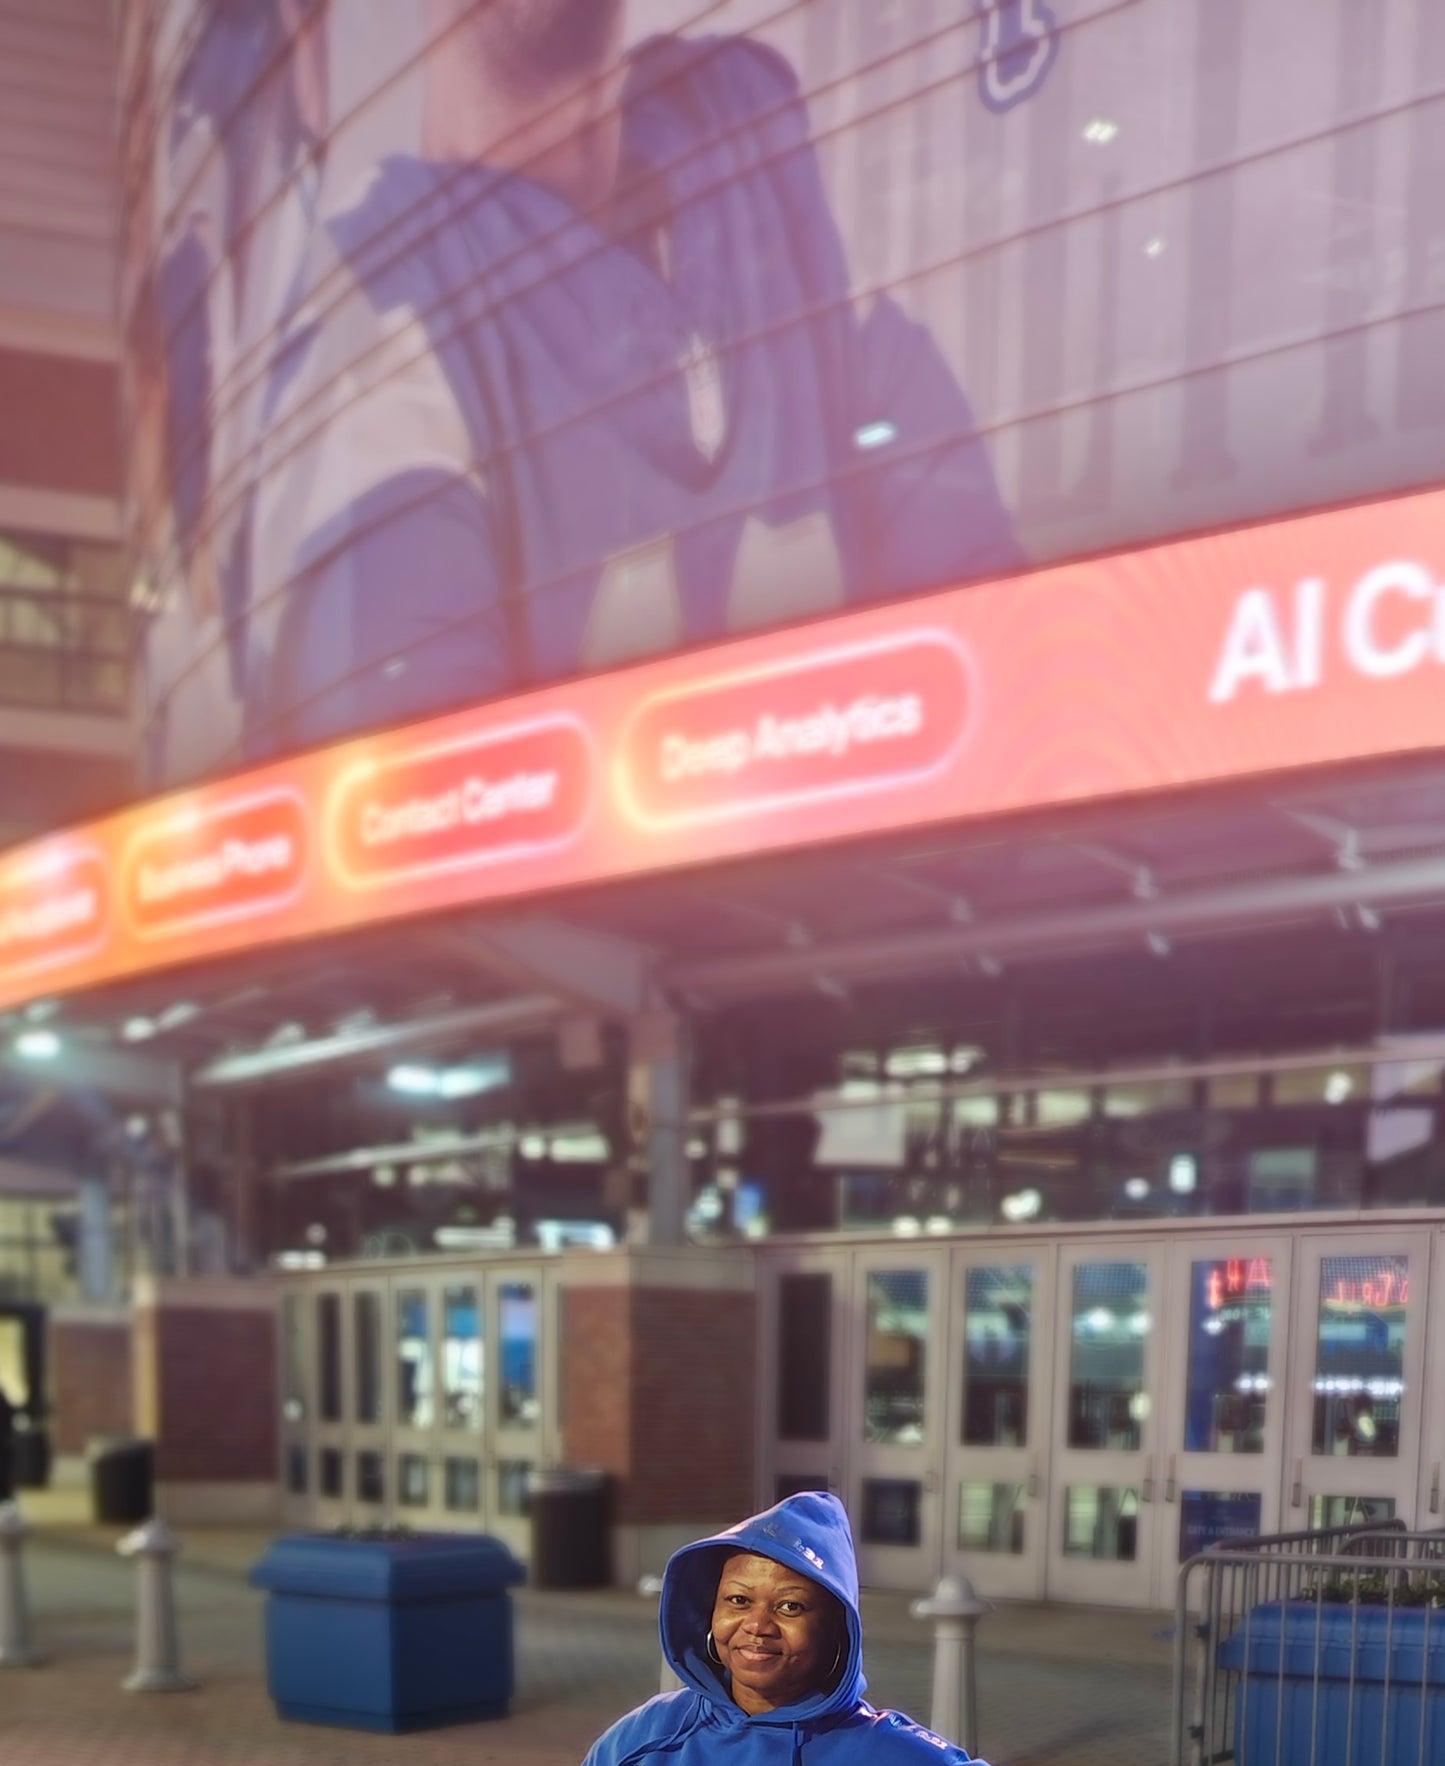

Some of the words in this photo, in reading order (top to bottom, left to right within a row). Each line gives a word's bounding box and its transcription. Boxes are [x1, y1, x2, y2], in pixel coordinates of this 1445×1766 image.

[1208, 577, 1323, 704] AI
[661, 731, 749, 781] Deep
[755, 692, 923, 757] Analytics
